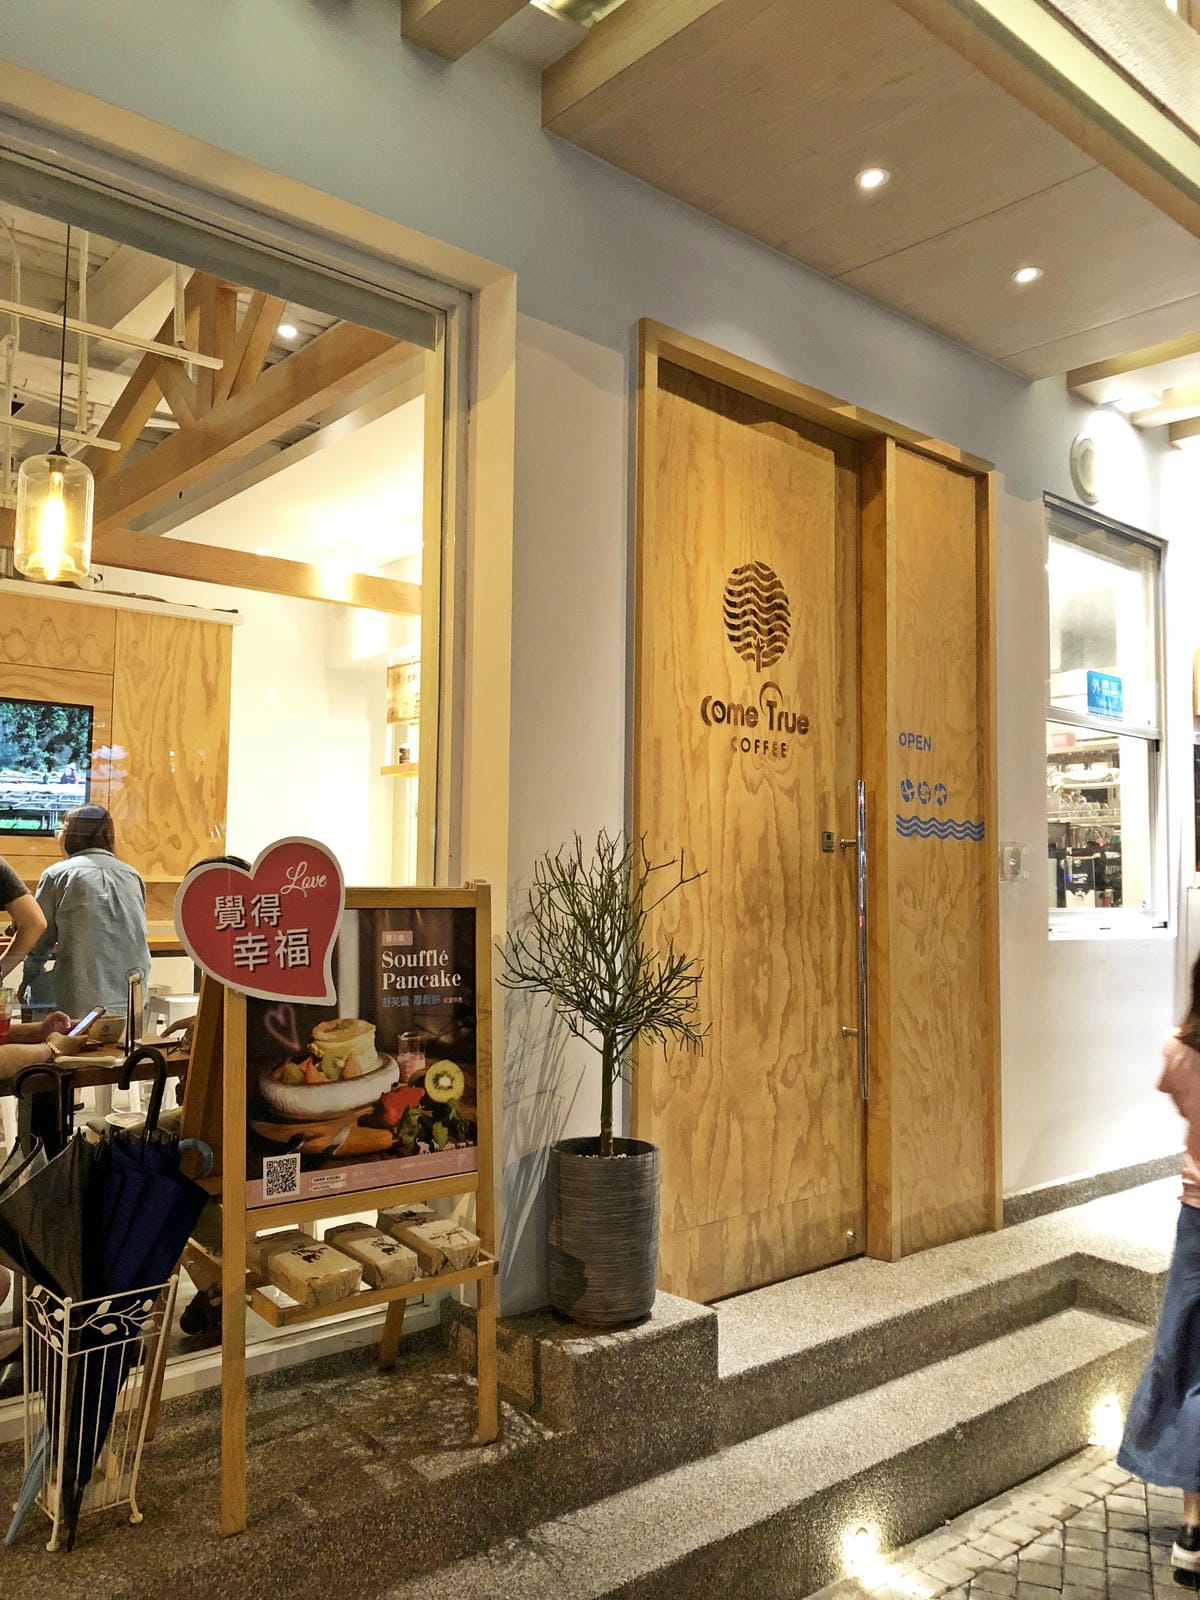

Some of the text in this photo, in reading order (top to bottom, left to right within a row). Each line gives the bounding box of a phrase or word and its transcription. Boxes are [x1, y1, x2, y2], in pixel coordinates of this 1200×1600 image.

[700, 695, 810, 735] Come True
[730, 736, 787, 758] COFFEE
[898, 732, 932, 752] OPEN
[280, 861, 327, 898] Love
[214, 893, 282, 930] 覺得
[233, 928, 310, 972] 幸福
[381, 949, 449, 969] Soufflé
[382, 970, 462, 991] Pancake
